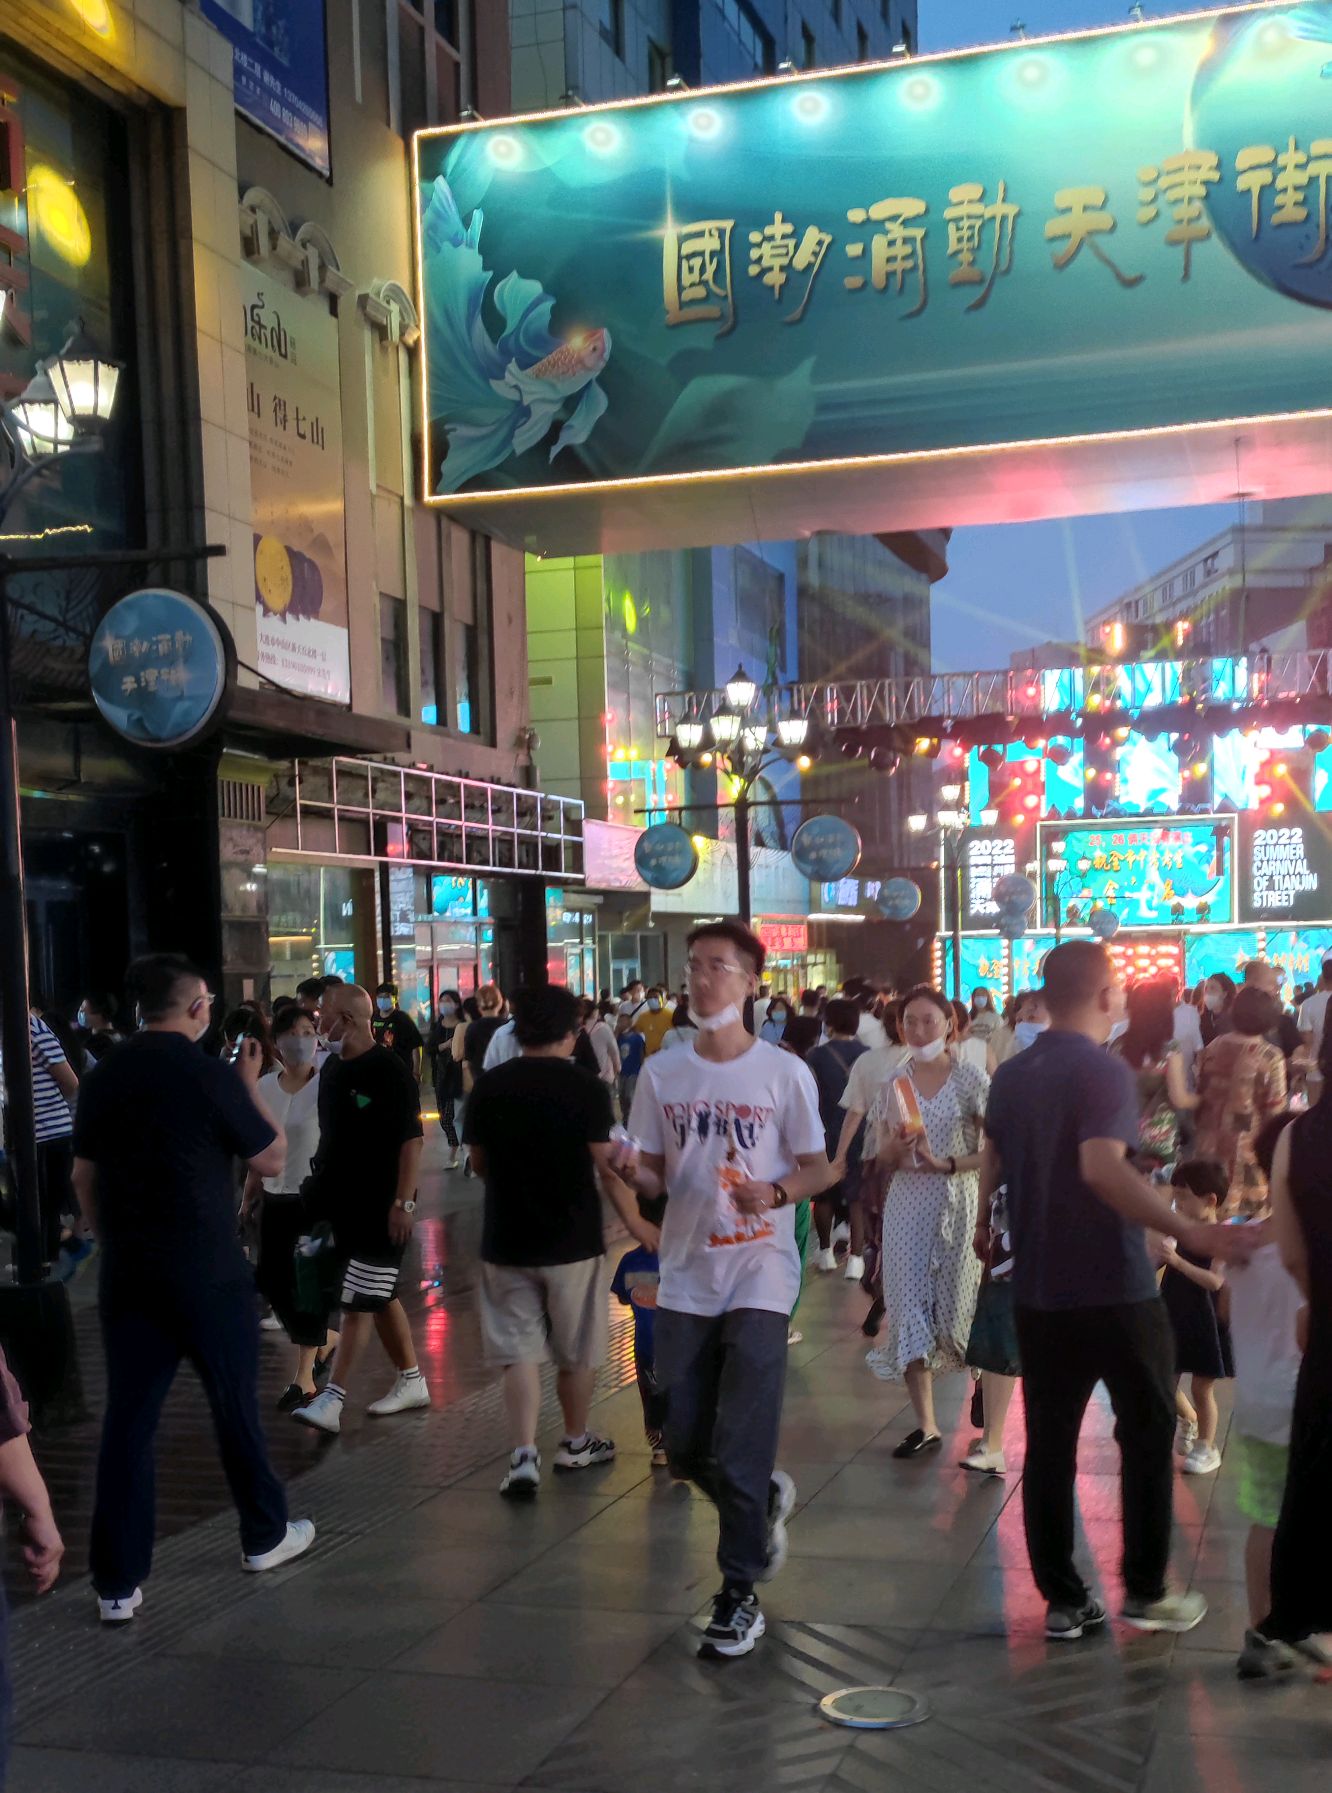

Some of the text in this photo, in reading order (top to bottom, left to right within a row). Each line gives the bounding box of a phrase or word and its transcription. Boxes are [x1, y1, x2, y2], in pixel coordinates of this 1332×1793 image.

[1253, 828, 1303, 846] 2022
[969, 839, 1015, 855] 2022
[1253, 844, 1304, 861] SUMMER
[1253, 859, 1310, 876] CARNIVAL
[1253, 873, 1318, 891] OF TIANJIN
[1253, 890, 1295, 908] STREET
